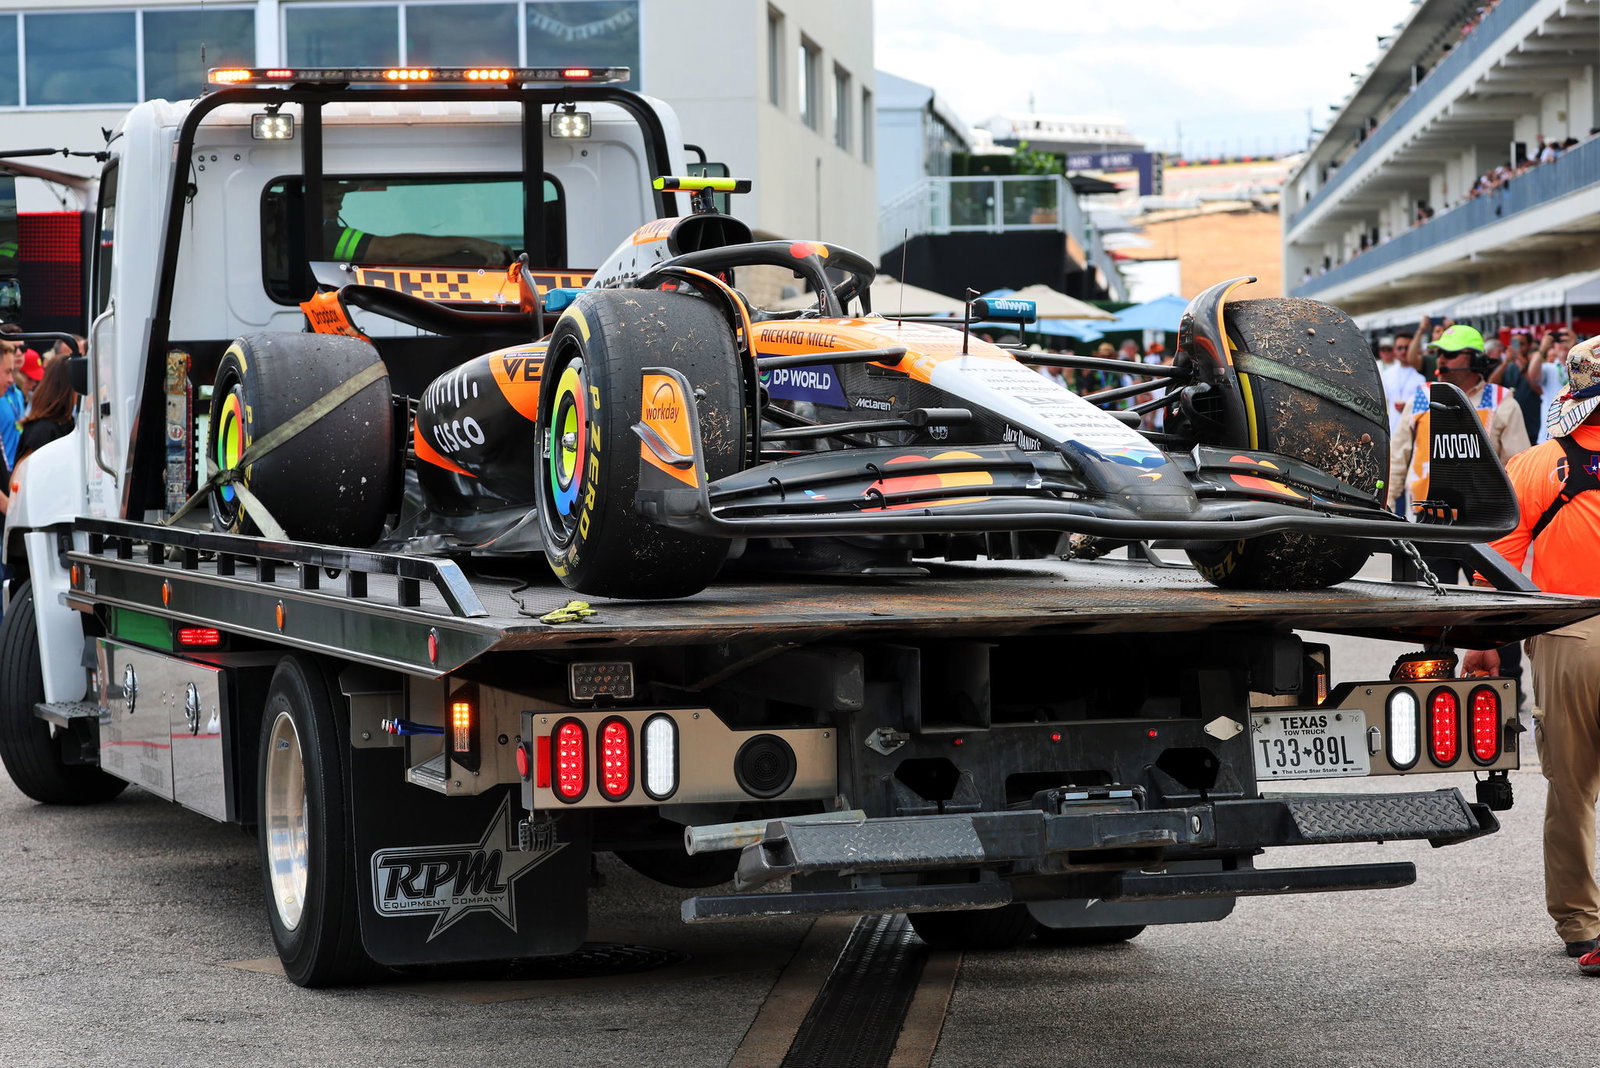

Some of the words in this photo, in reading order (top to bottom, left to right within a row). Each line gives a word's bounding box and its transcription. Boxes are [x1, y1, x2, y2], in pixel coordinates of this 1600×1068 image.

[994, 299, 1030, 314] allwyn
[311, 307, 341, 328] Dropbox
[760, 328, 804, 345] RICHARD
[807, 332, 837, 349] MILLE
[773, 368, 789, 386] DP
[789, 369, 831, 390] WORLD
[645, 403, 680, 424] workday
[855, 397, 891, 412] McLaren
[1002, 423, 1018, 443] JACK
[1433, 433, 1480, 459] ARROW
[579, 425, 601, 541] ZERO
[1280, 715, 1327, 730] TEXAS
[379, 849, 508, 900] RPM
[384, 900, 447, 910] EQUIPMENT
[451, 896, 505, 905] COMPANY
